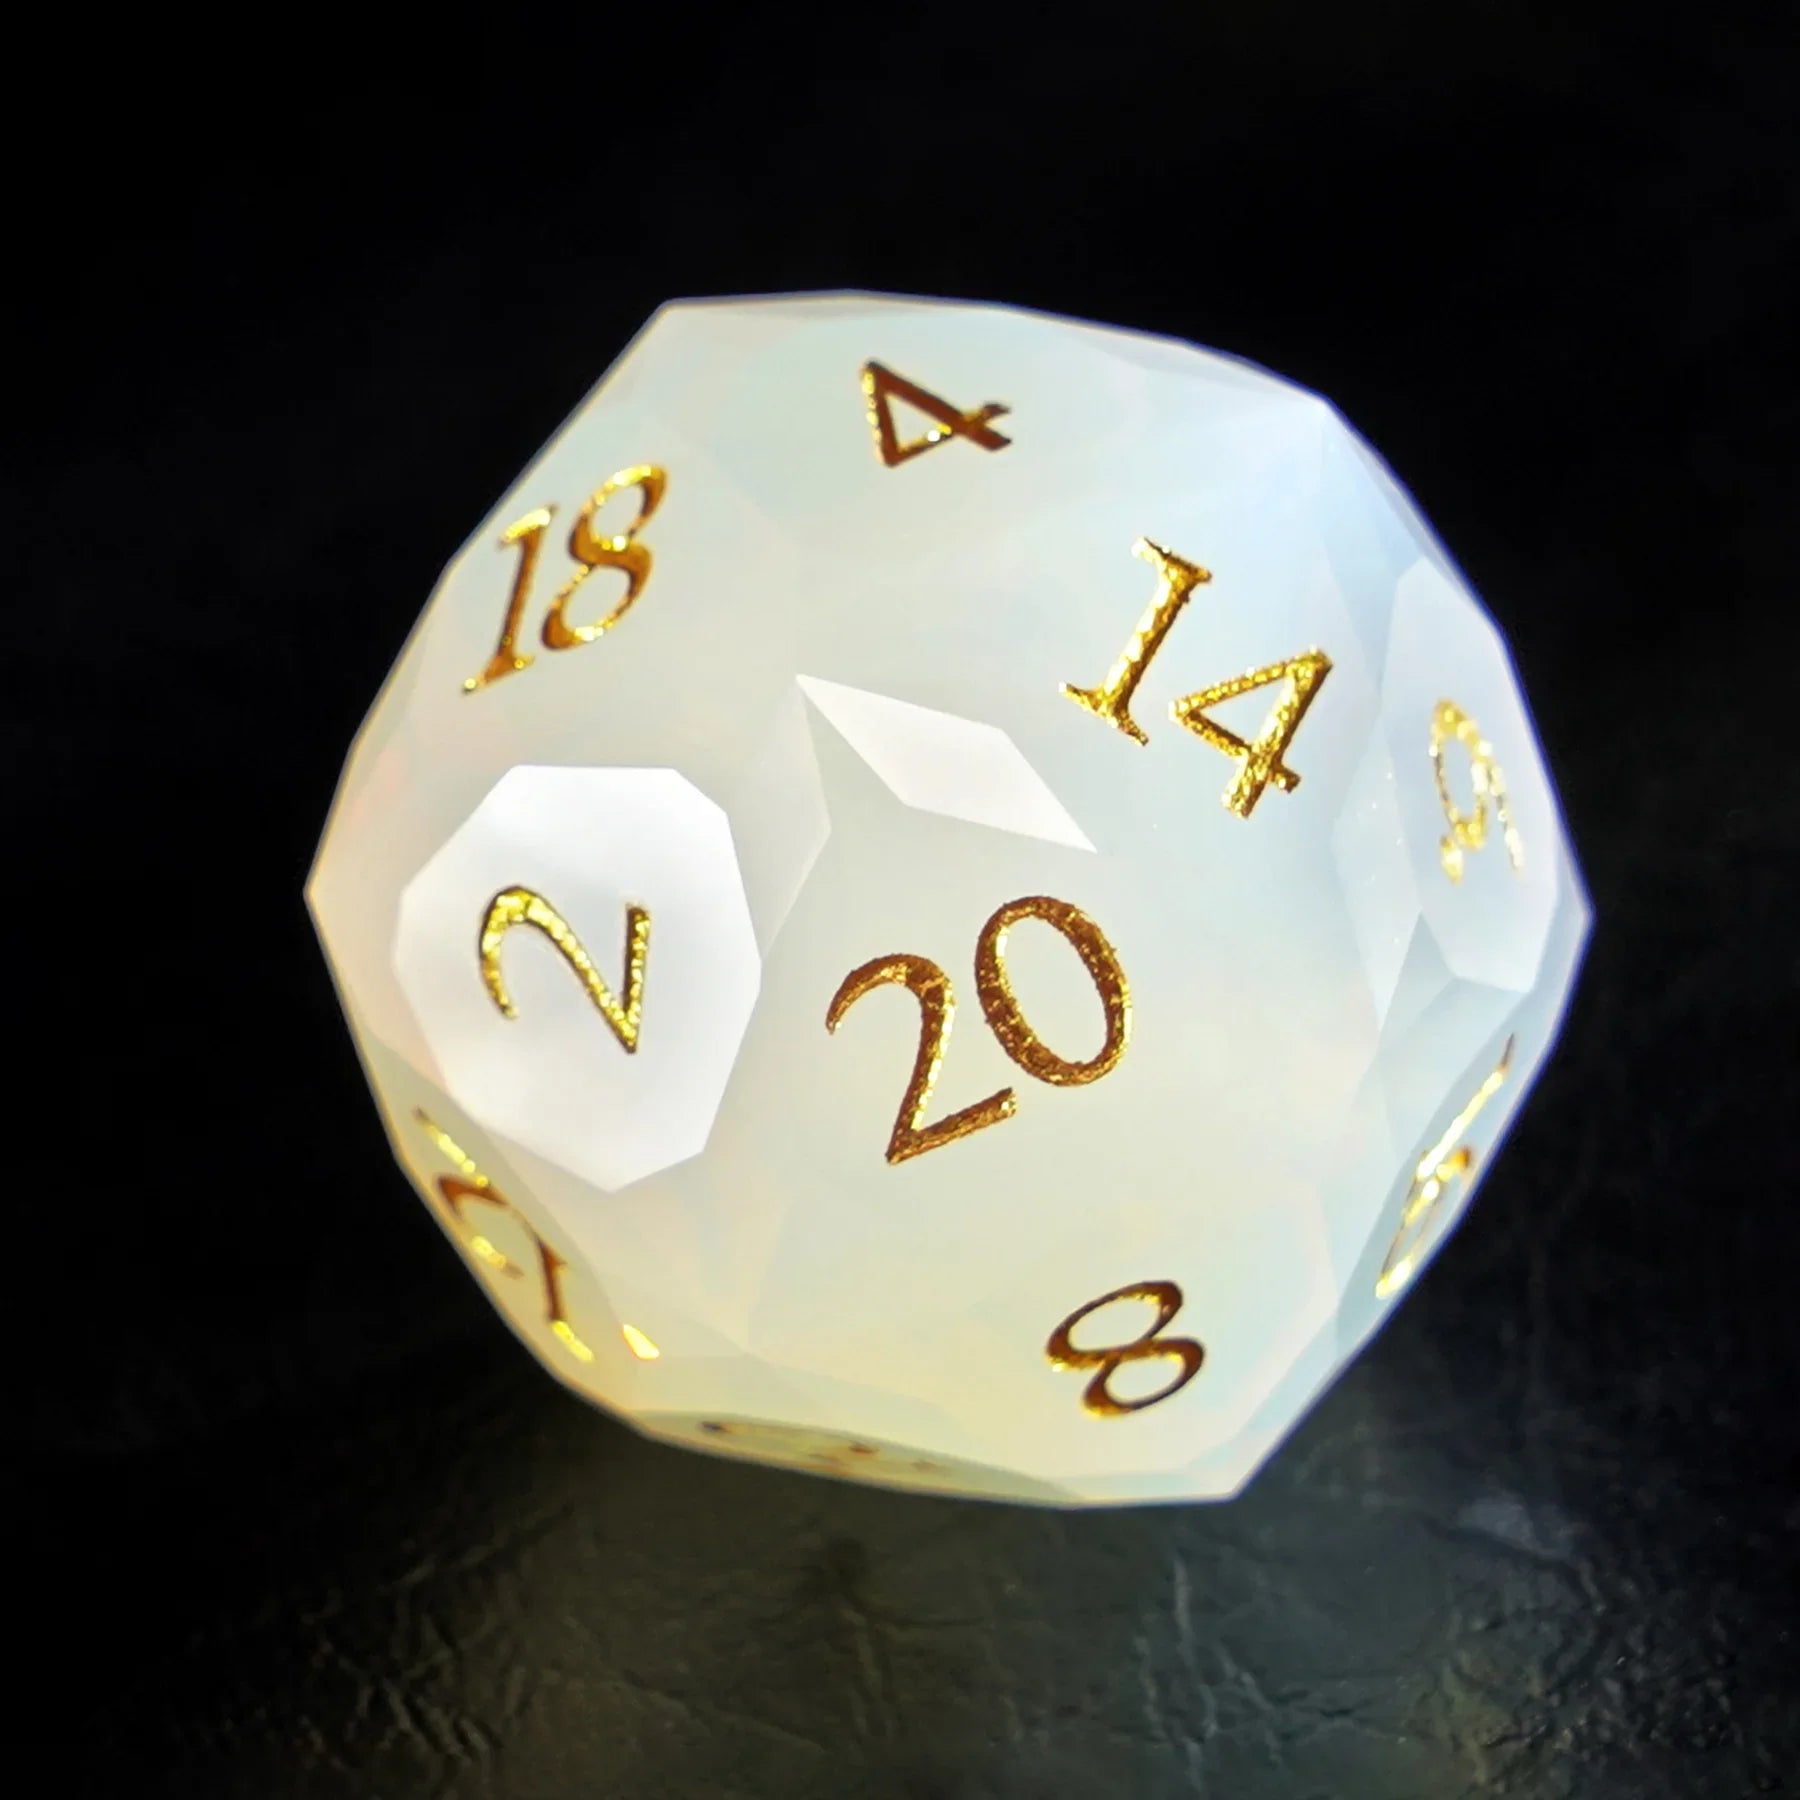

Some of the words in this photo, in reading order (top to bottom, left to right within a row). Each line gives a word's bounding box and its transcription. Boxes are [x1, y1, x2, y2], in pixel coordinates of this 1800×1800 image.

[860, 358, 1012, 467] 4
[461, 463, 668, 696] 18
[1058, 535, 1333, 820] 14
[478, 886, 651, 1054] 2
[825, 894, 1134, 1165] 20
[1045, 1279, 1206, 1419] 8
